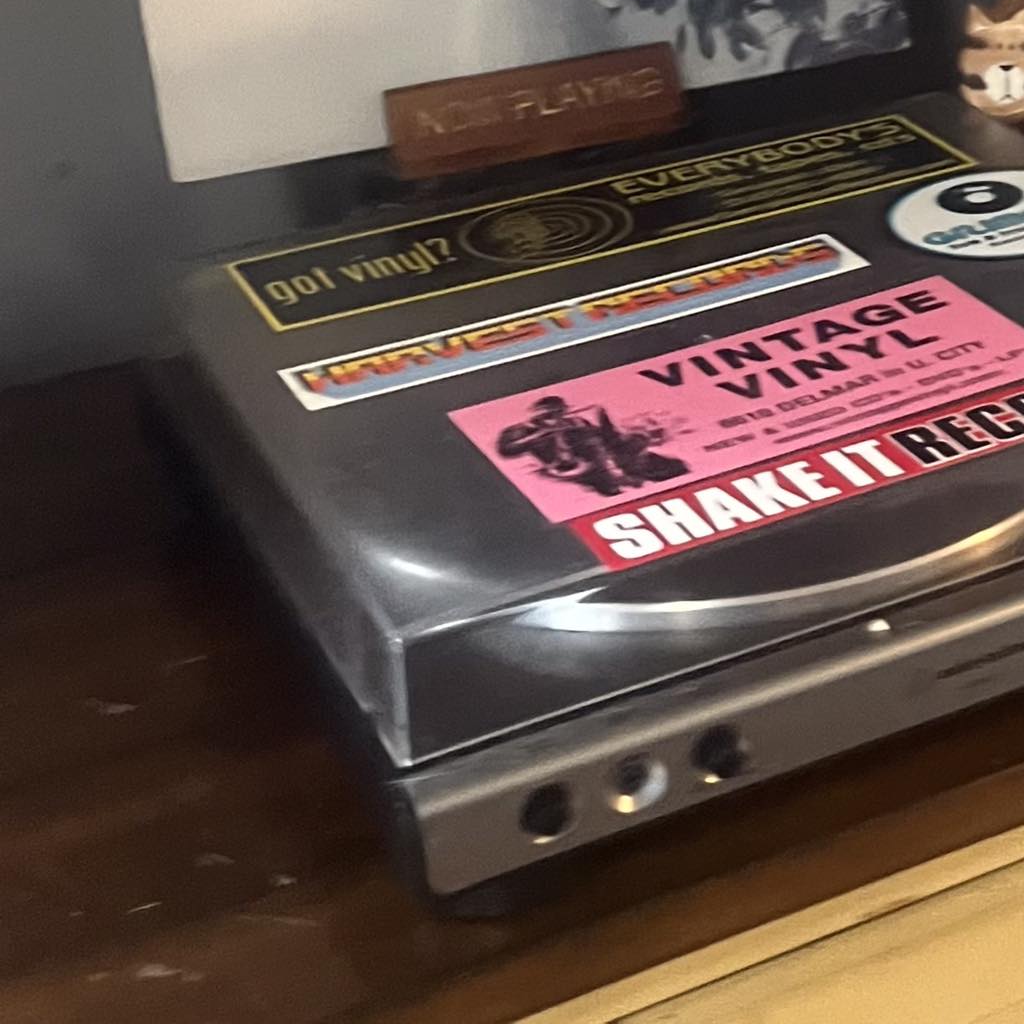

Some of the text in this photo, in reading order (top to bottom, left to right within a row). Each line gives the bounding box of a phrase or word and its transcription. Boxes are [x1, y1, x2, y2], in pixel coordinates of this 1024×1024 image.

[266, 237, 458, 306] got vinyl?
[638, 289, 949, 387] VINTAGE
[716, 330, 941, 399] VINYL
[933, 340, 985, 361] CITY
[592, 460, 843, 560] SHAKE
[820, 439, 906, 488] IT
